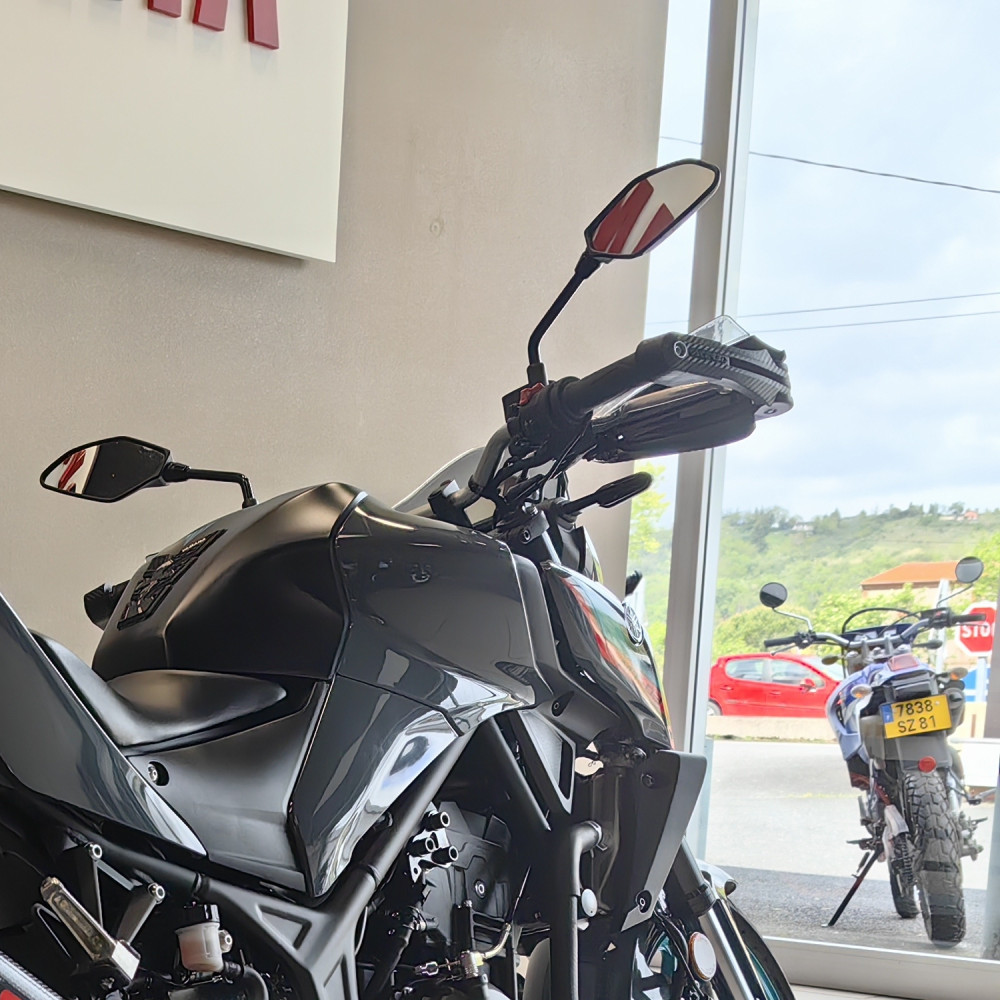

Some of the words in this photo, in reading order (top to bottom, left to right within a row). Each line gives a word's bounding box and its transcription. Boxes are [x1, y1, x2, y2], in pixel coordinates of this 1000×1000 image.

[961, 621, 995, 639] STO
[895, 699, 933, 717] 7838
[897, 718, 916, 733] SZ
[919, 715, 936, 730] 81
